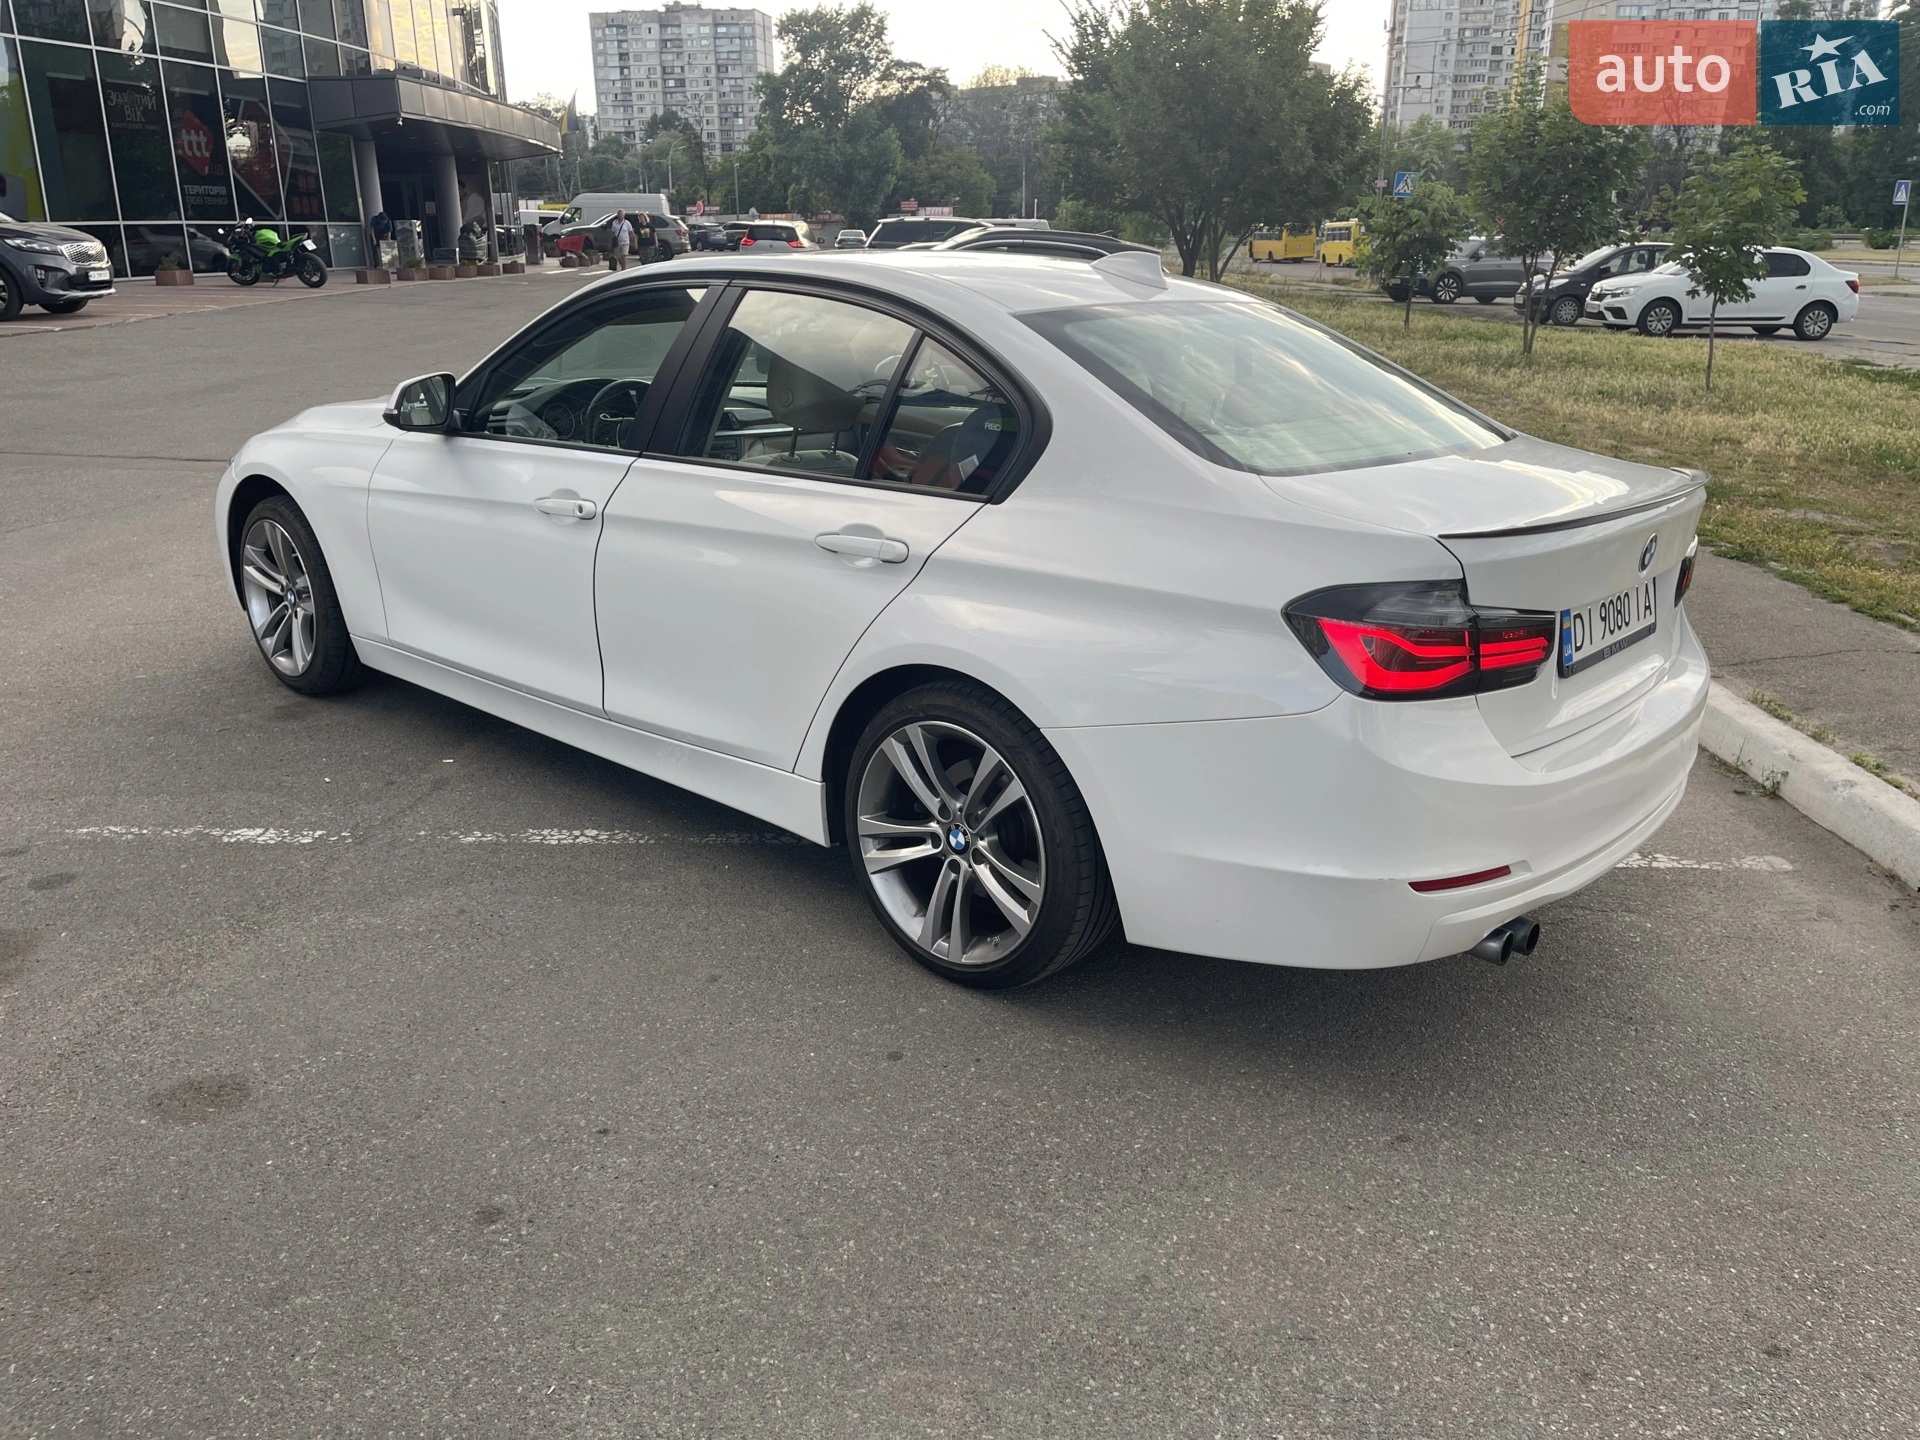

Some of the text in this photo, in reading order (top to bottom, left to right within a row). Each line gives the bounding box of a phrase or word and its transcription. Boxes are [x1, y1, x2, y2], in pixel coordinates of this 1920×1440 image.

[183, 184, 227, 196] ТЕРИТОРІЯ
[1573, 582, 1652, 652] DI 9080 IA
[1563, 643, 1573, 657] UA
[1603, 639, 1629, 659] BMW
[950, 824, 971, 842] BMW
